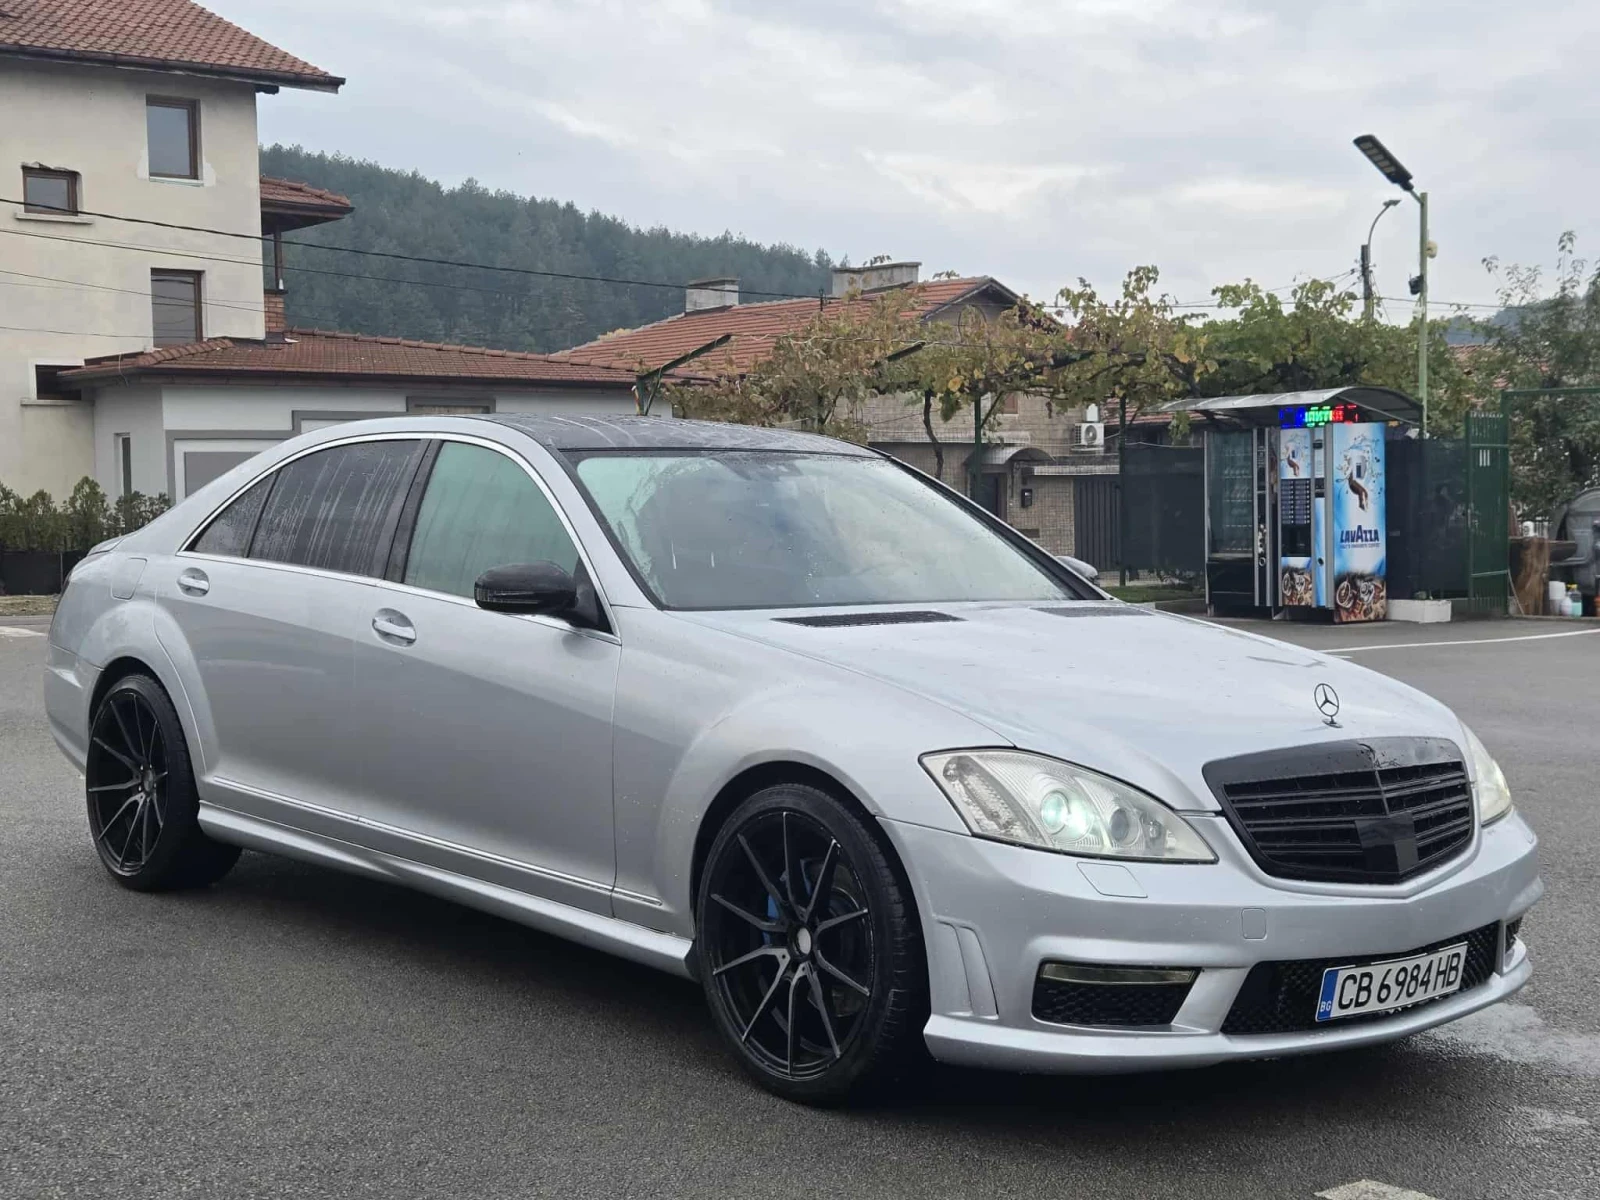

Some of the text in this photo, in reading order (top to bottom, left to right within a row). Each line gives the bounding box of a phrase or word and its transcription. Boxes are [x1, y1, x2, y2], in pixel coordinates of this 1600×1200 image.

[1340, 524, 1380, 543] LAVAZZA
[1338, 952, 1461, 1010] CB 6984 HB
[1319, 1000, 1332, 1012] BG
